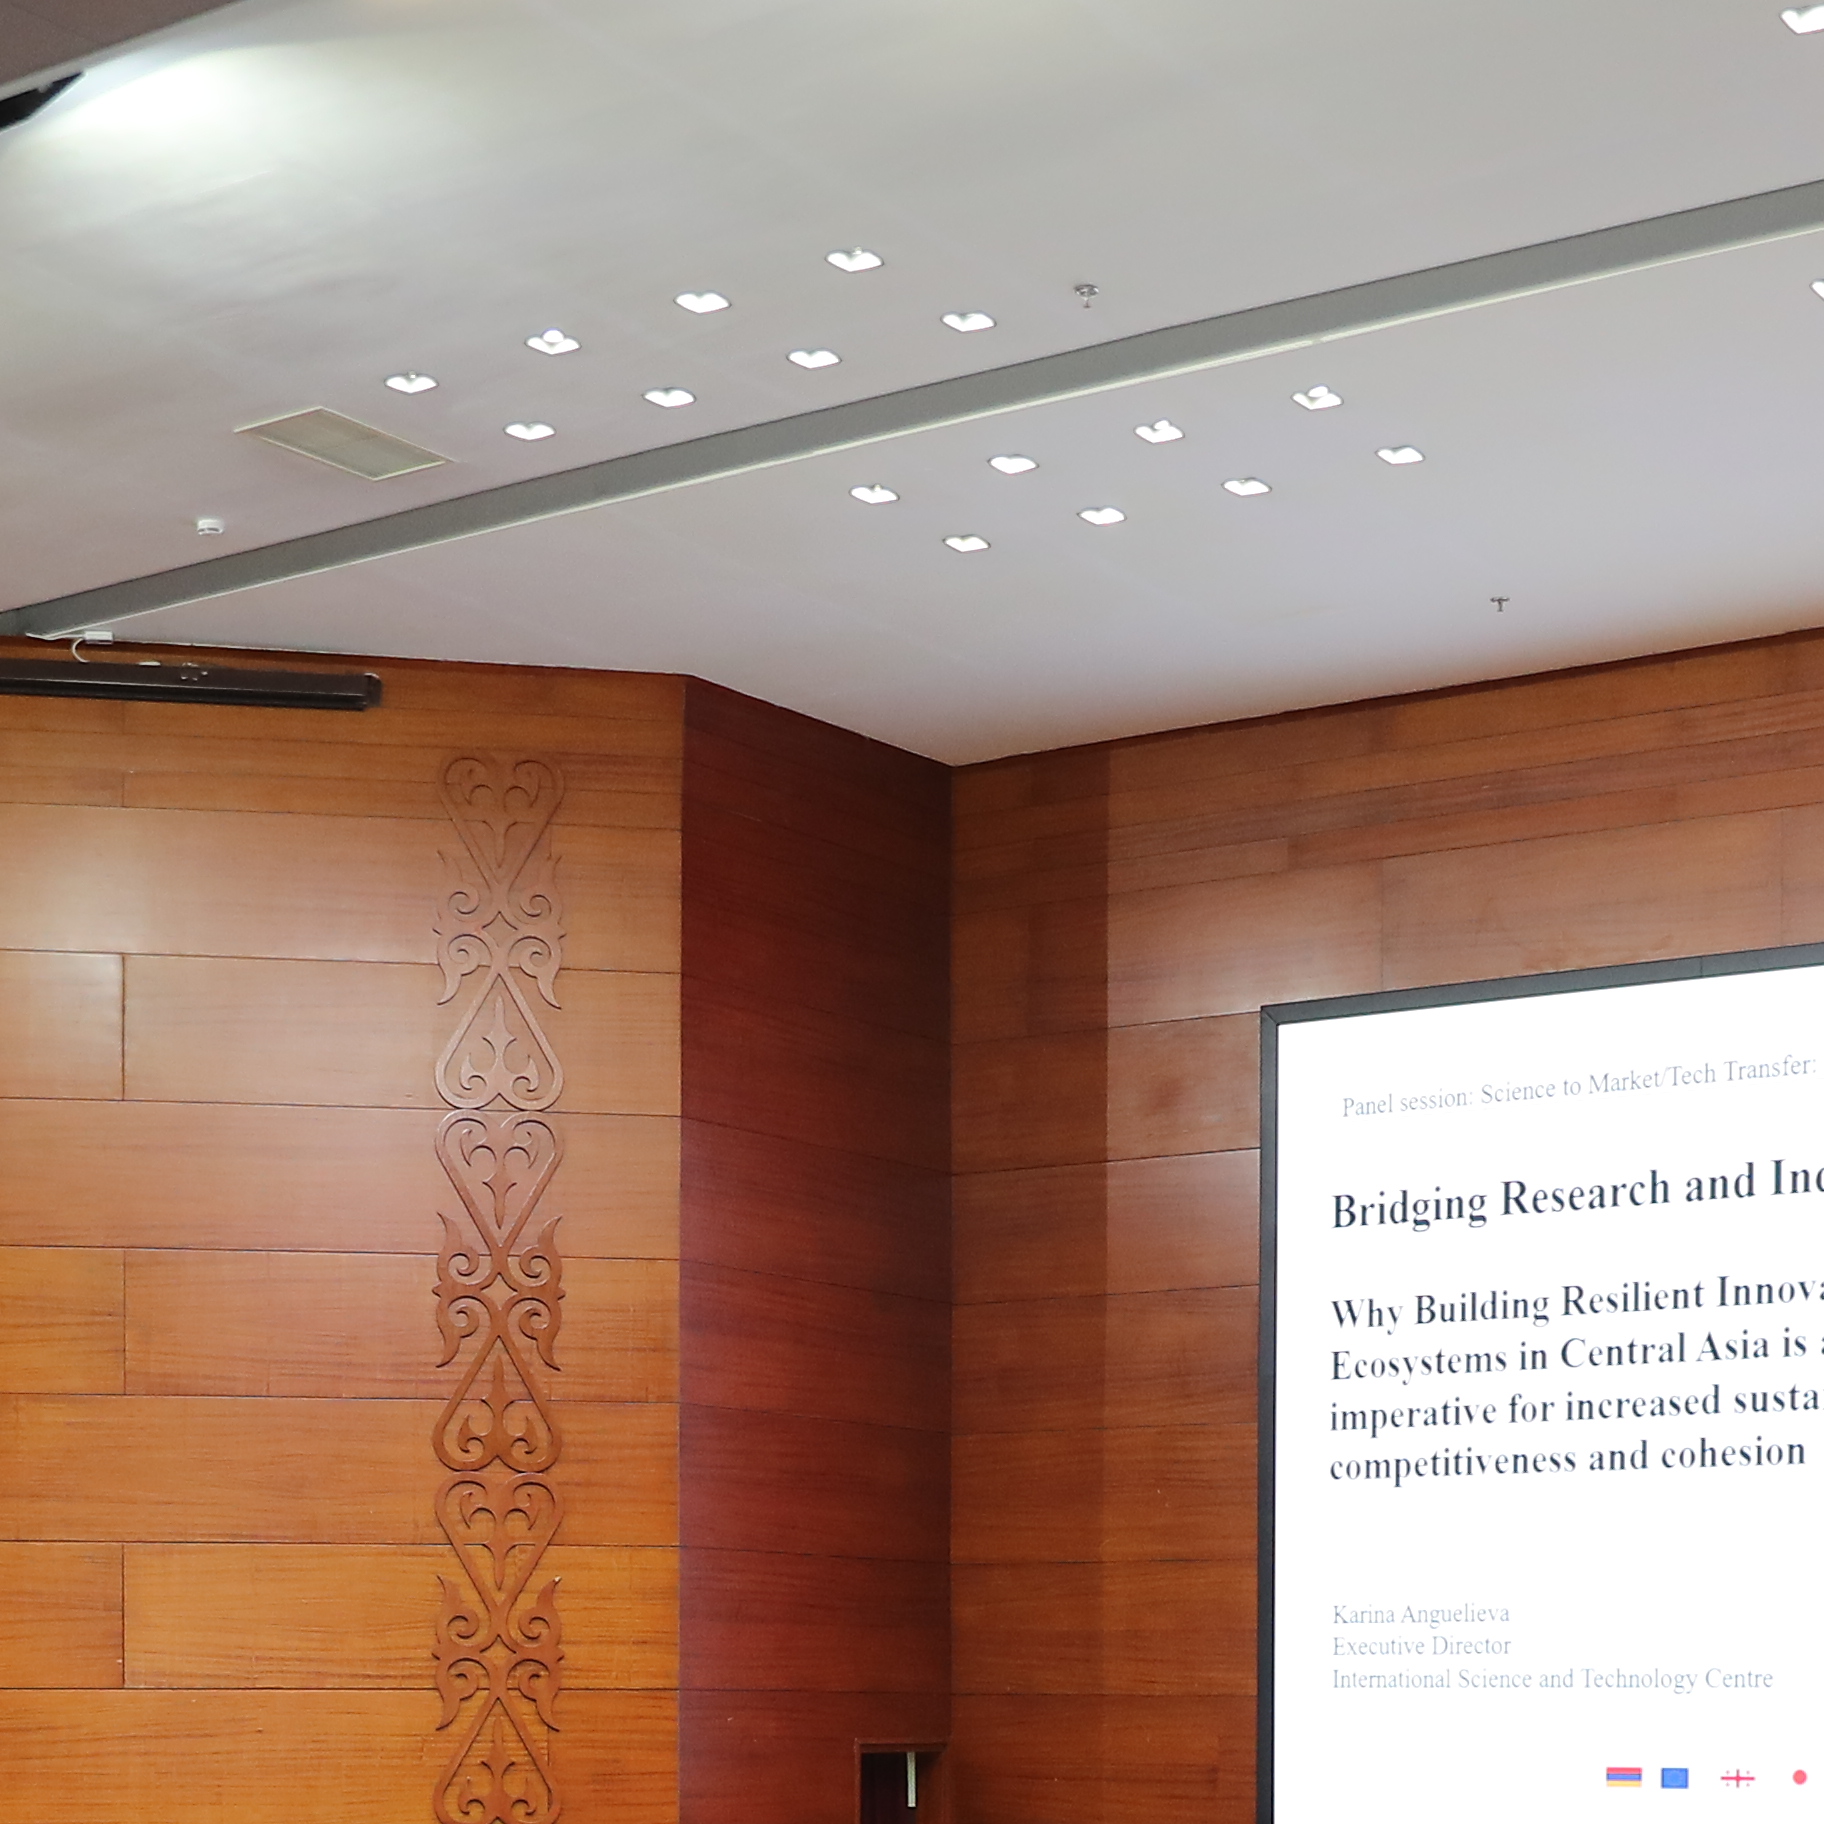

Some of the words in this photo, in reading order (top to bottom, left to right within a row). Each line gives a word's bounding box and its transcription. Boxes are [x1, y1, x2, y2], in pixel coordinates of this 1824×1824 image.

[1342, 1093, 1394, 1118] Panel
[1400, 1088, 1473, 1112] session:
[1481, 1083, 1556, 1104] Science
[1563, 1079, 1582, 1096] to
[1588, 1062, 1717, 1095] Market/Tech
[1723, 1053, 1816, 1082] Transfer:
[1332, 1185, 1488, 1233] Bridging
[1501, 1169, 1670, 1216] Research
[1685, 1161, 1756, 1203] and
[1332, 1298, 1401, 1336] Why
[1415, 1289, 1550, 1326] Building
[1561, 1281, 1705, 1316] Resilient
[1331, 1349, 1507, 1386] Ecosystems
[1519, 1341, 1548, 1371] in
[1560, 1331, 1686, 1368] Central
[1695, 1328, 1769, 1362] Asia
[1783, 1326, 1807, 1358] is
[1331, 1396, 1497, 1439] imperative
[1508, 1393, 1556, 1424] for
[1566, 1383, 1721, 1421] increased
[1330, 1446, 1576, 1487] competitiveness
[1589, 1439, 1649, 1472] and
[1661, 1435, 1805, 1469] cohesion
[1332, 1605, 1396, 1625] Karina
[1400, 1602, 1510, 1630] Anguelieva
[1332, 1636, 1425, 1656] Executive
[1432, 1635, 1512, 1656] Director
[1332, 1668, 1451, 1689] International
[1458, 1668, 1533, 1689] Science
[1538, 1667, 1574, 1689] and
[1580, 1667, 1698, 1695] Technology
[1704, 1667, 1774, 1689] Centre
